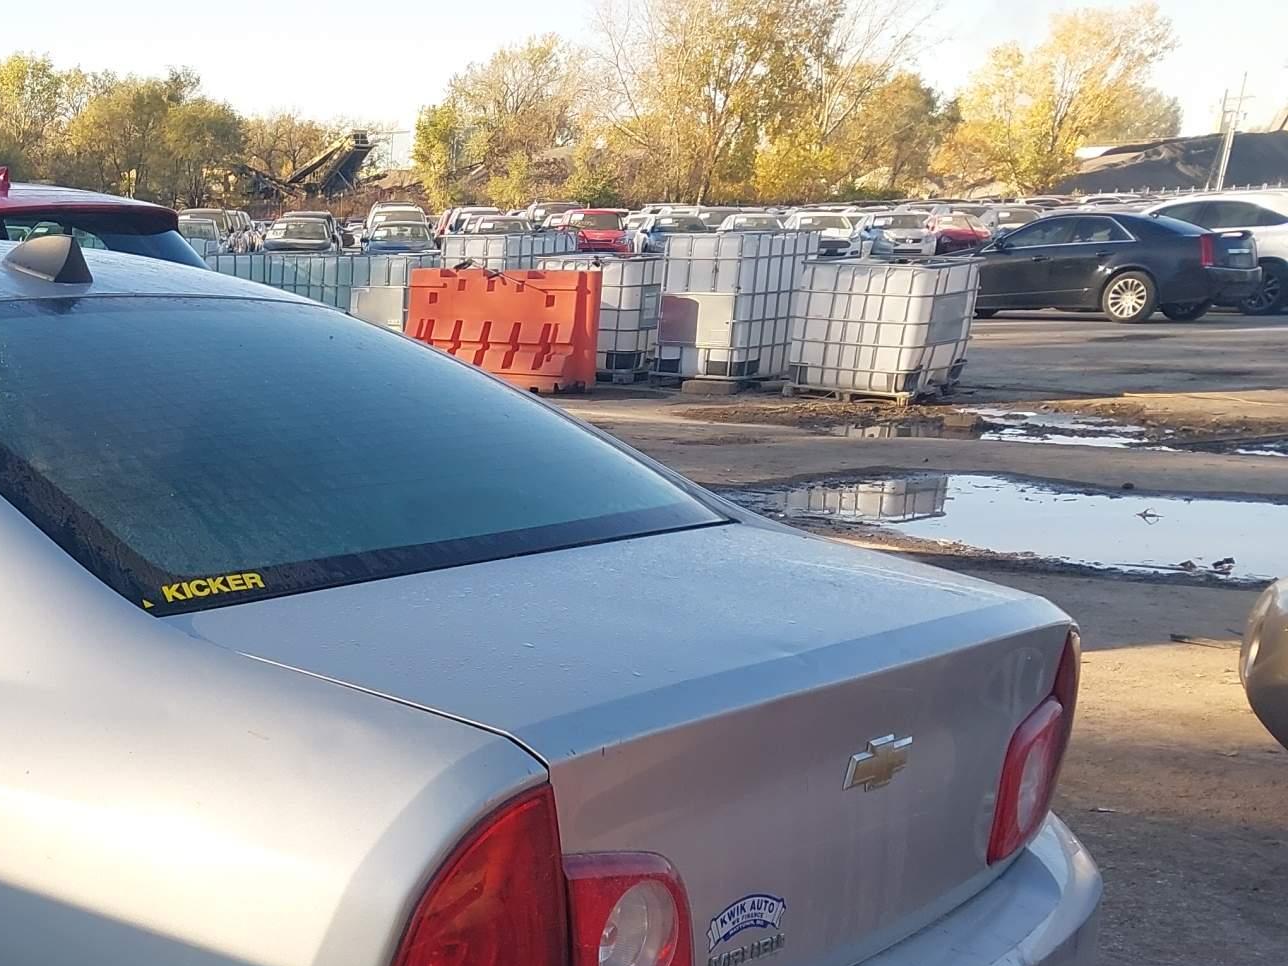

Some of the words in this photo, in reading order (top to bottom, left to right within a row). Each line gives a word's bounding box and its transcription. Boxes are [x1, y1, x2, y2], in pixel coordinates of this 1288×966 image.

[161, 572, 266, 603] KICKER
[720, 902, 747, 928] KWIK
[750, 898, 775, 914] AUTO
